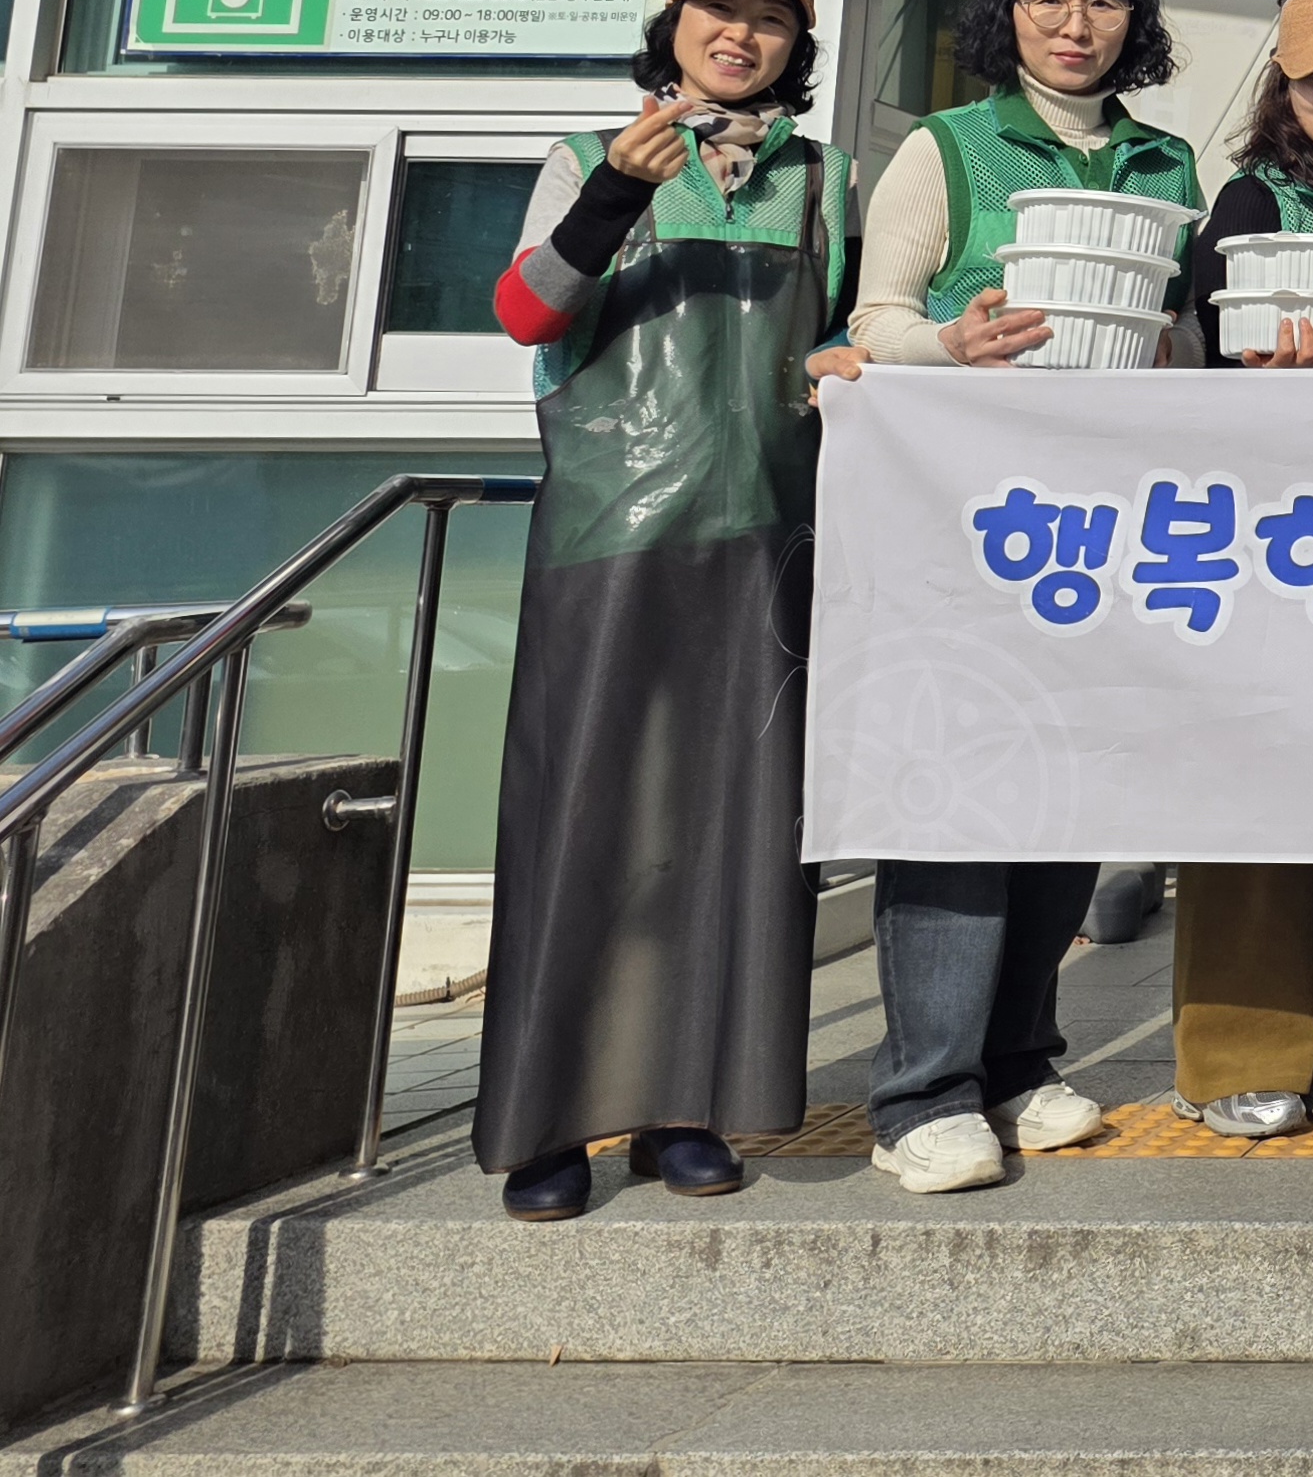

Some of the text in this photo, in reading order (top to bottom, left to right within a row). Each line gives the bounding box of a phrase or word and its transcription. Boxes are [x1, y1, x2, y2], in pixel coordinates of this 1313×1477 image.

[349, 7, 408, 22] 운영시간
[422, 9, 462, 21] 09:00
[347, 28, 406, 43] 이용대상
[419, 29, 460, 43] 누구나
[463, 28, 517, 44] 이용가능
